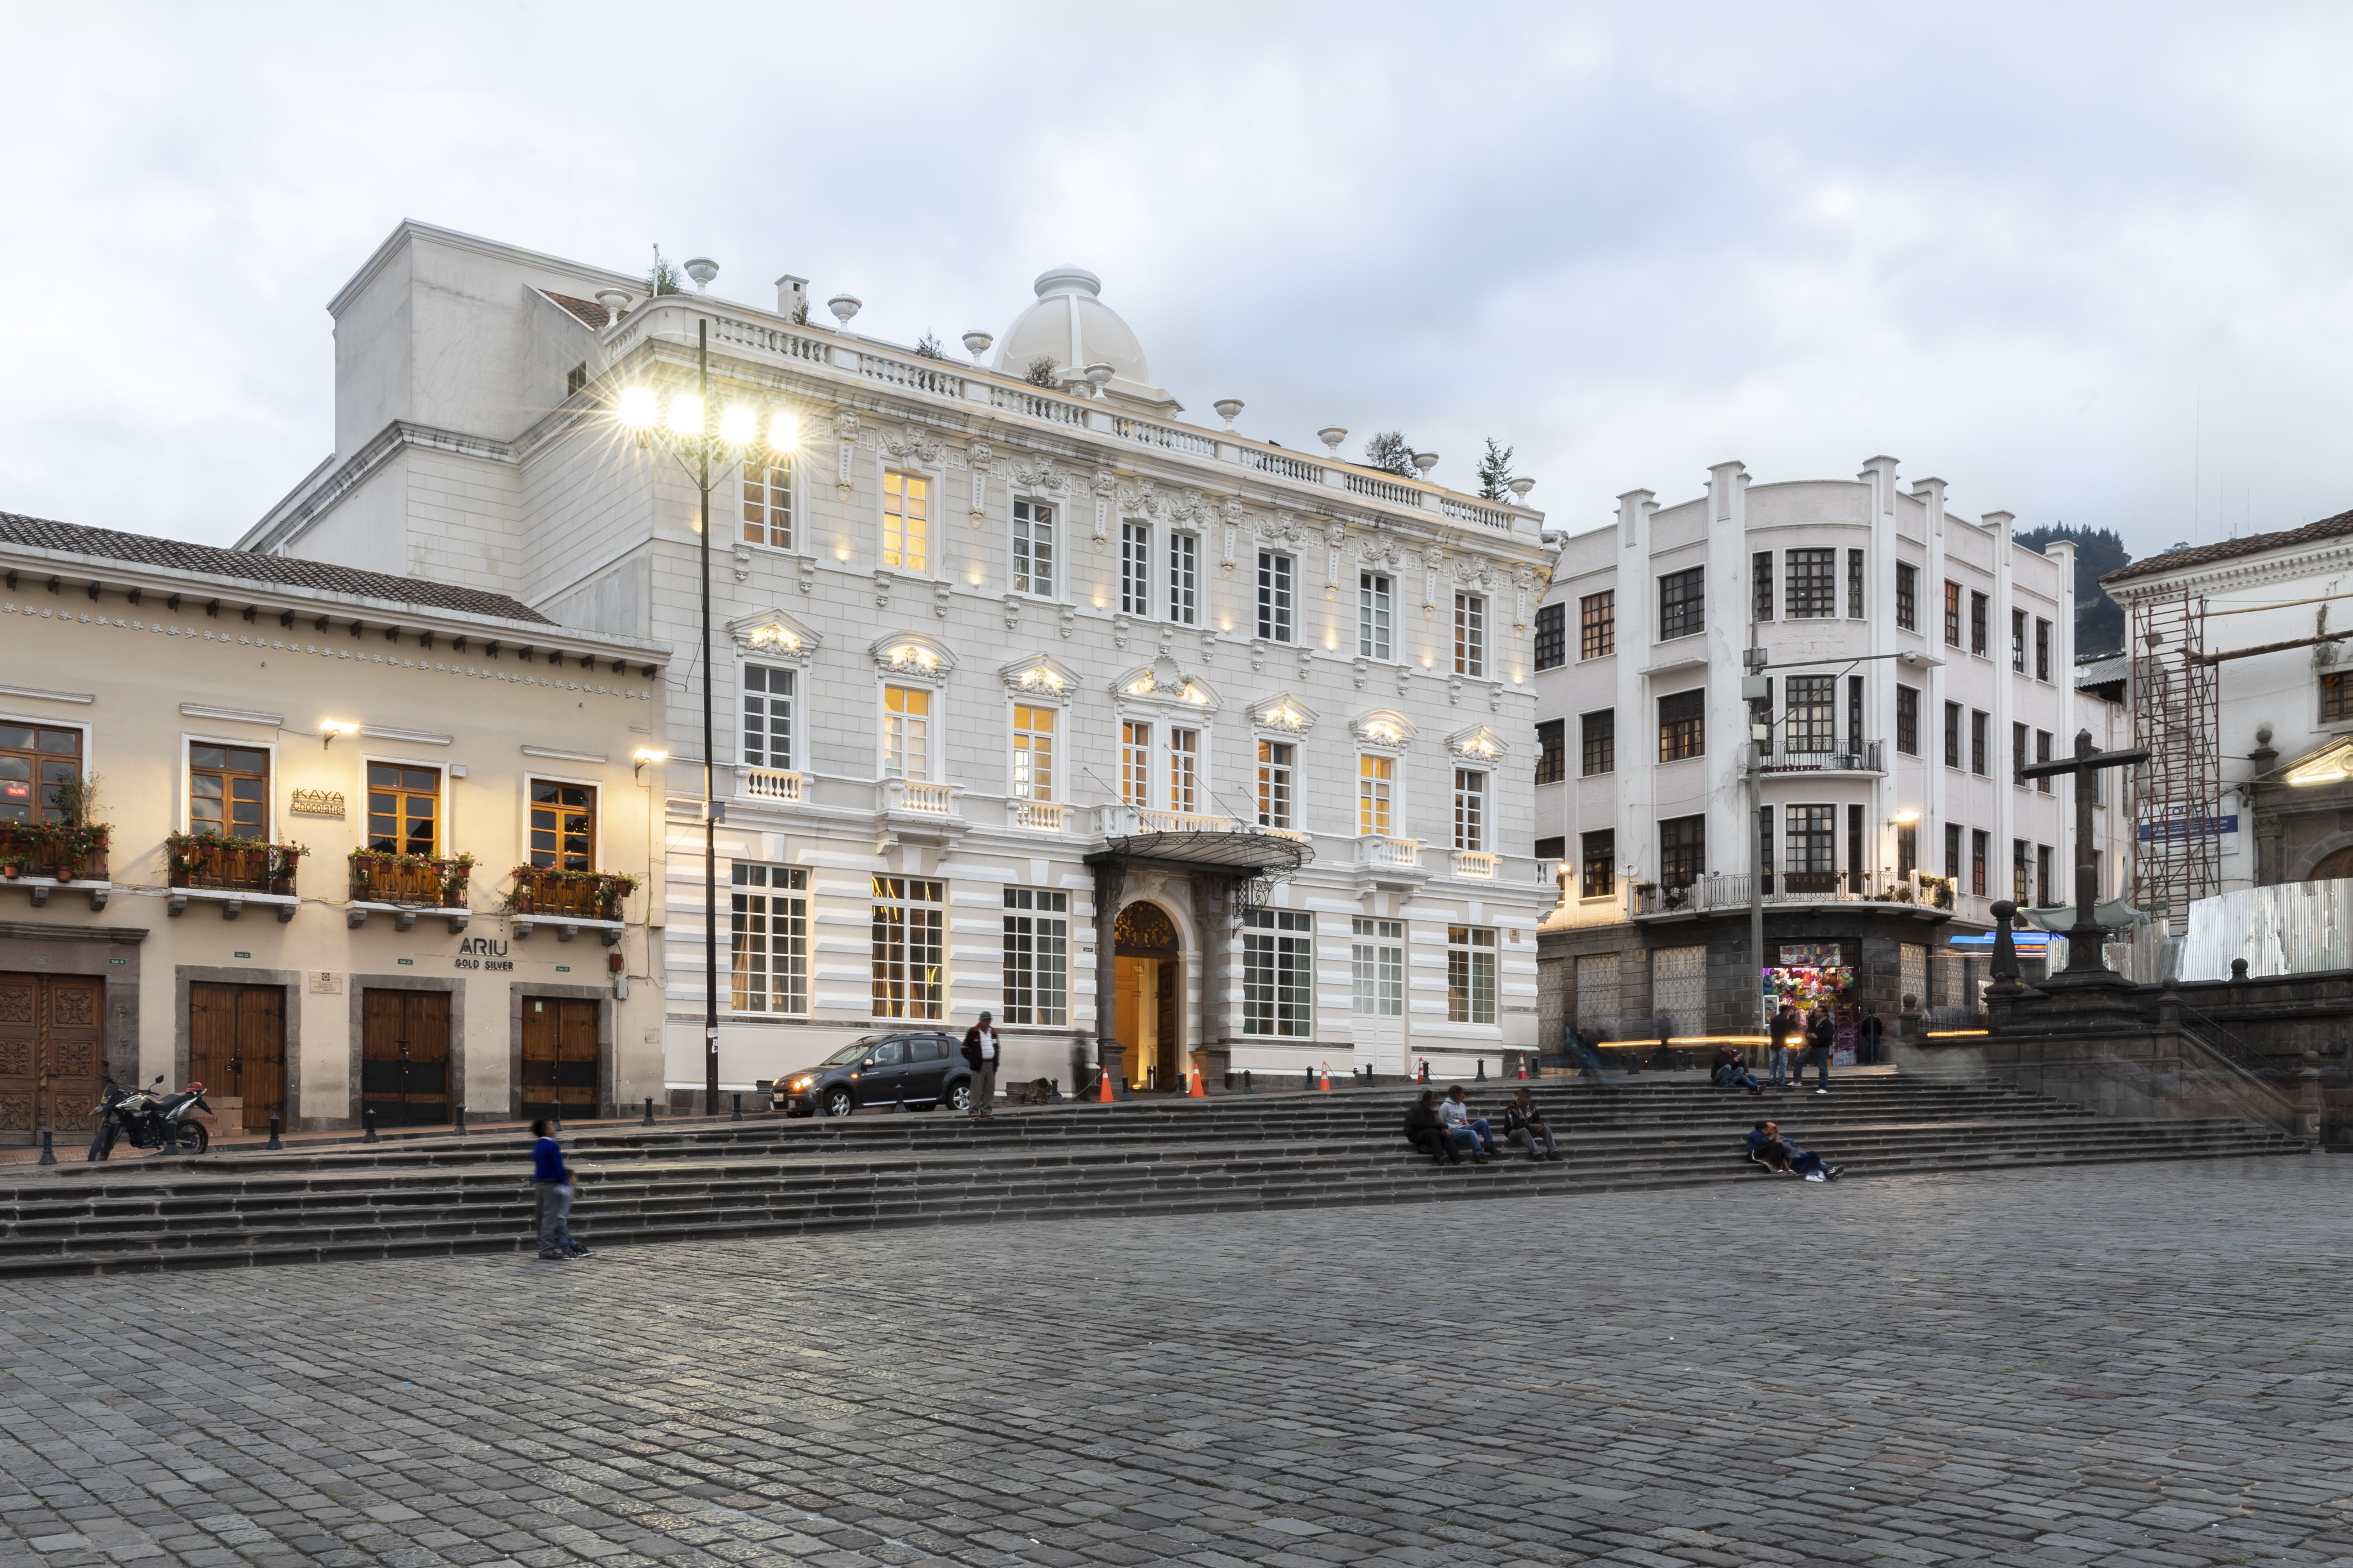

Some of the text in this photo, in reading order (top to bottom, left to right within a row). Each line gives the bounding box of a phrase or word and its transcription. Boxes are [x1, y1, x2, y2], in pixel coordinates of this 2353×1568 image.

[294, 788, 344, 803] KAYA
[292, 800, 345, 816] Chocolatier
[459, 937, 508, 956] ARIU
[455, 959, 513, 970] GOLD SILVER
